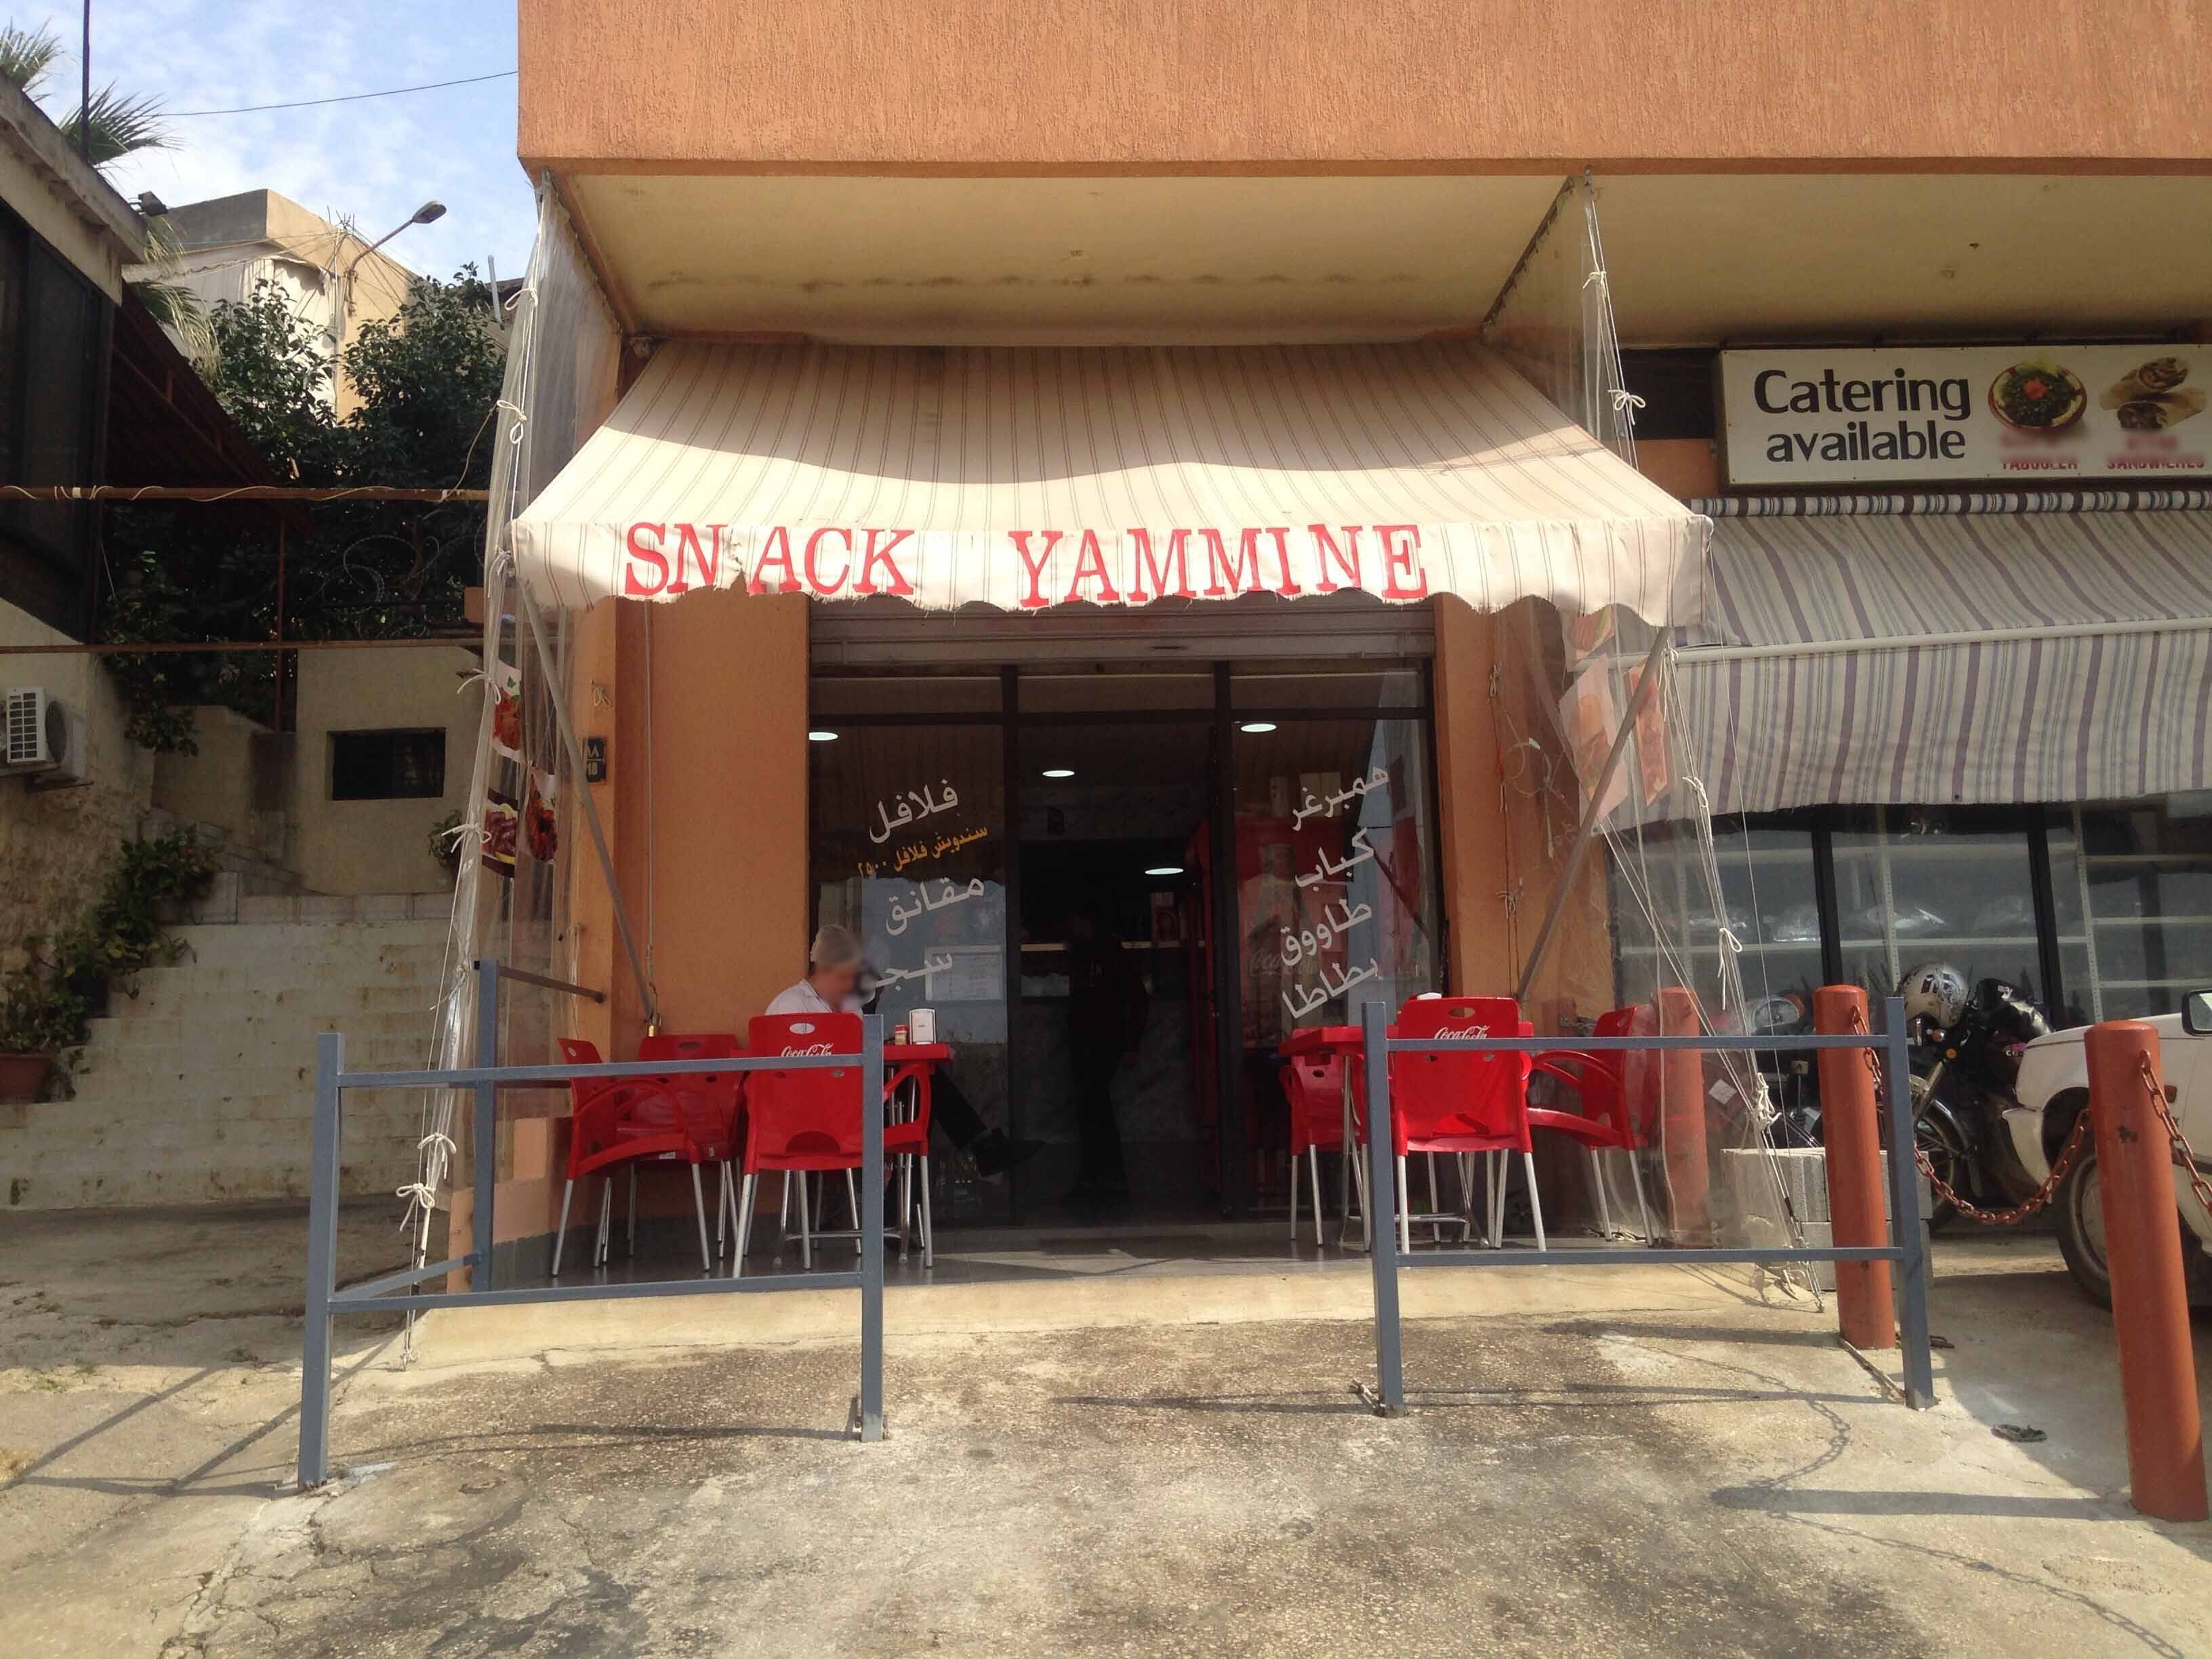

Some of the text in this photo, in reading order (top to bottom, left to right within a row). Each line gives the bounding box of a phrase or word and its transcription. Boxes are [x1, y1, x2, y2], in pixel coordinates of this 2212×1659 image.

[1753, 367, 1971, 422] Catering
[1765, 419, 1966, 463] available
[624, 521, 1429, 608] SNACK YAMMINE
[869, 779, 959, 844] فلافل
[1292, 766, 1389, 832] همبرغر
[894, 840, 928, 873] فلافل
[1295, 827, 1374, 893] كباب
[886, 877, 985, 937] مقانق
[1280, 898, 1372, 966] طاووق
[867, 953, 954, 1004] سج
[1282, 957, 1383, 1019] بطاطا
